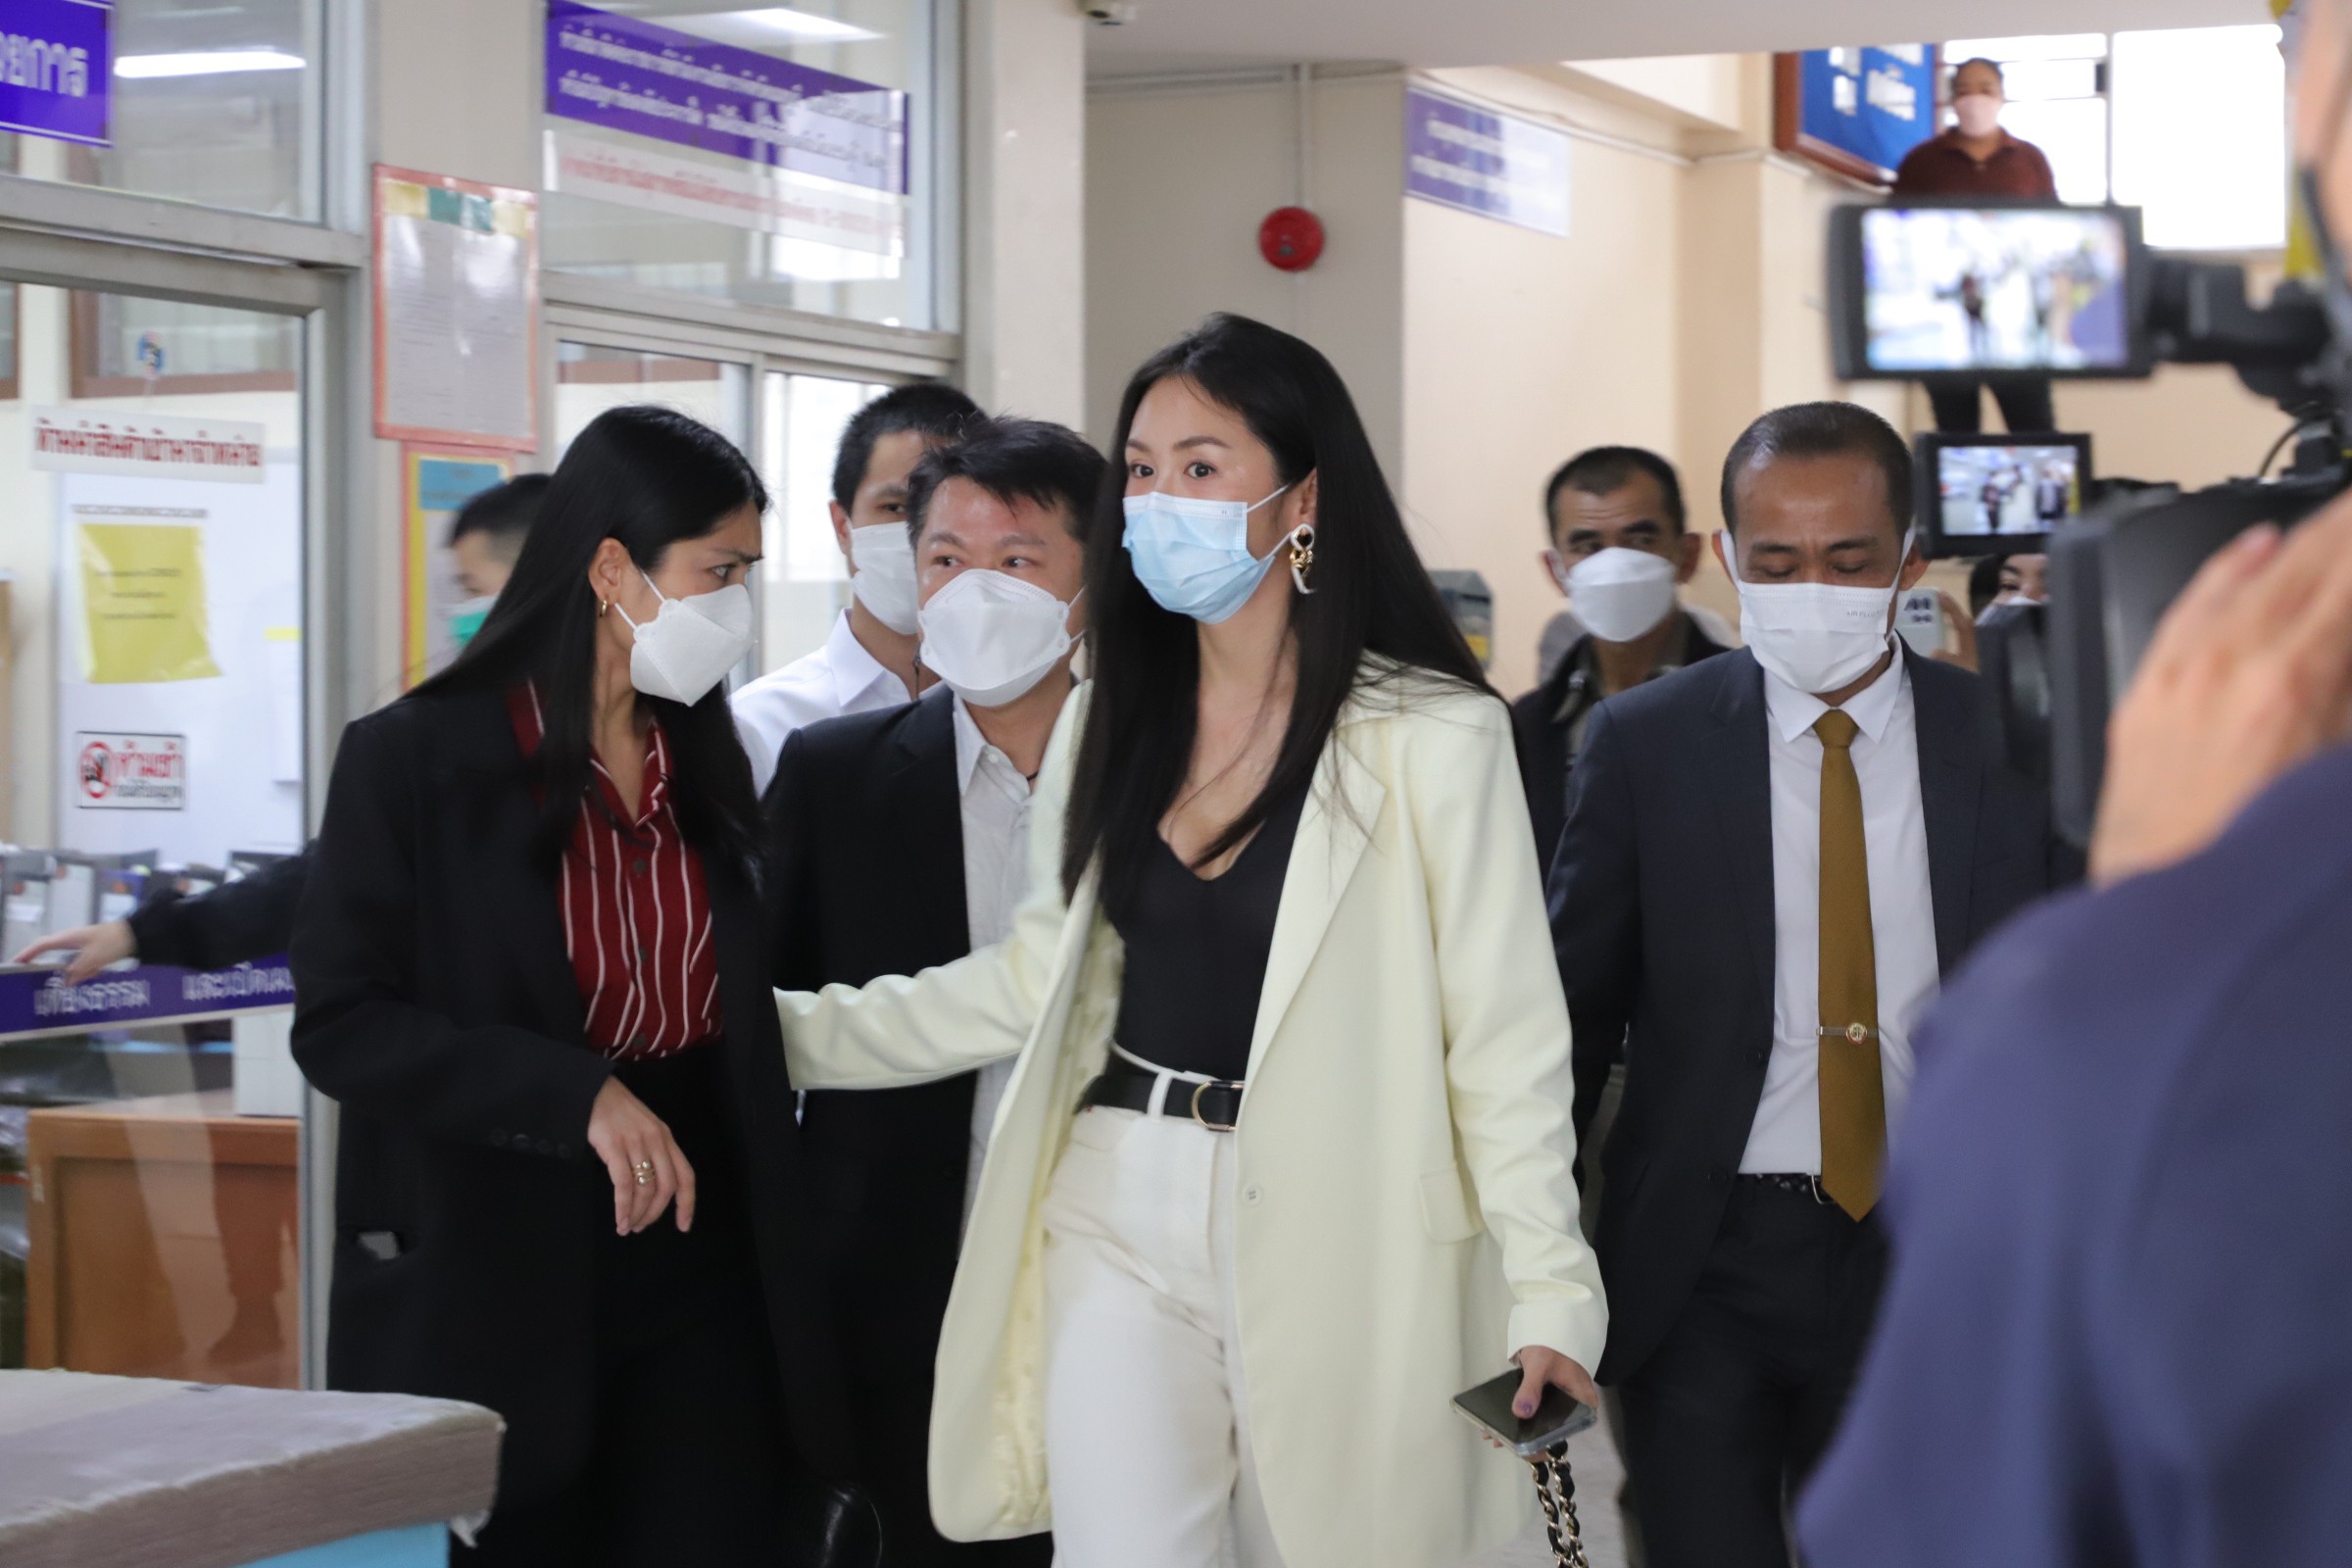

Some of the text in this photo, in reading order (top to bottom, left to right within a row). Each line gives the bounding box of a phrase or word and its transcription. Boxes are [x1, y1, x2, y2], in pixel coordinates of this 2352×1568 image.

[0, 30, 89, 98] ยการ
[184, 960, 295, 1001] และเปิดเผ
